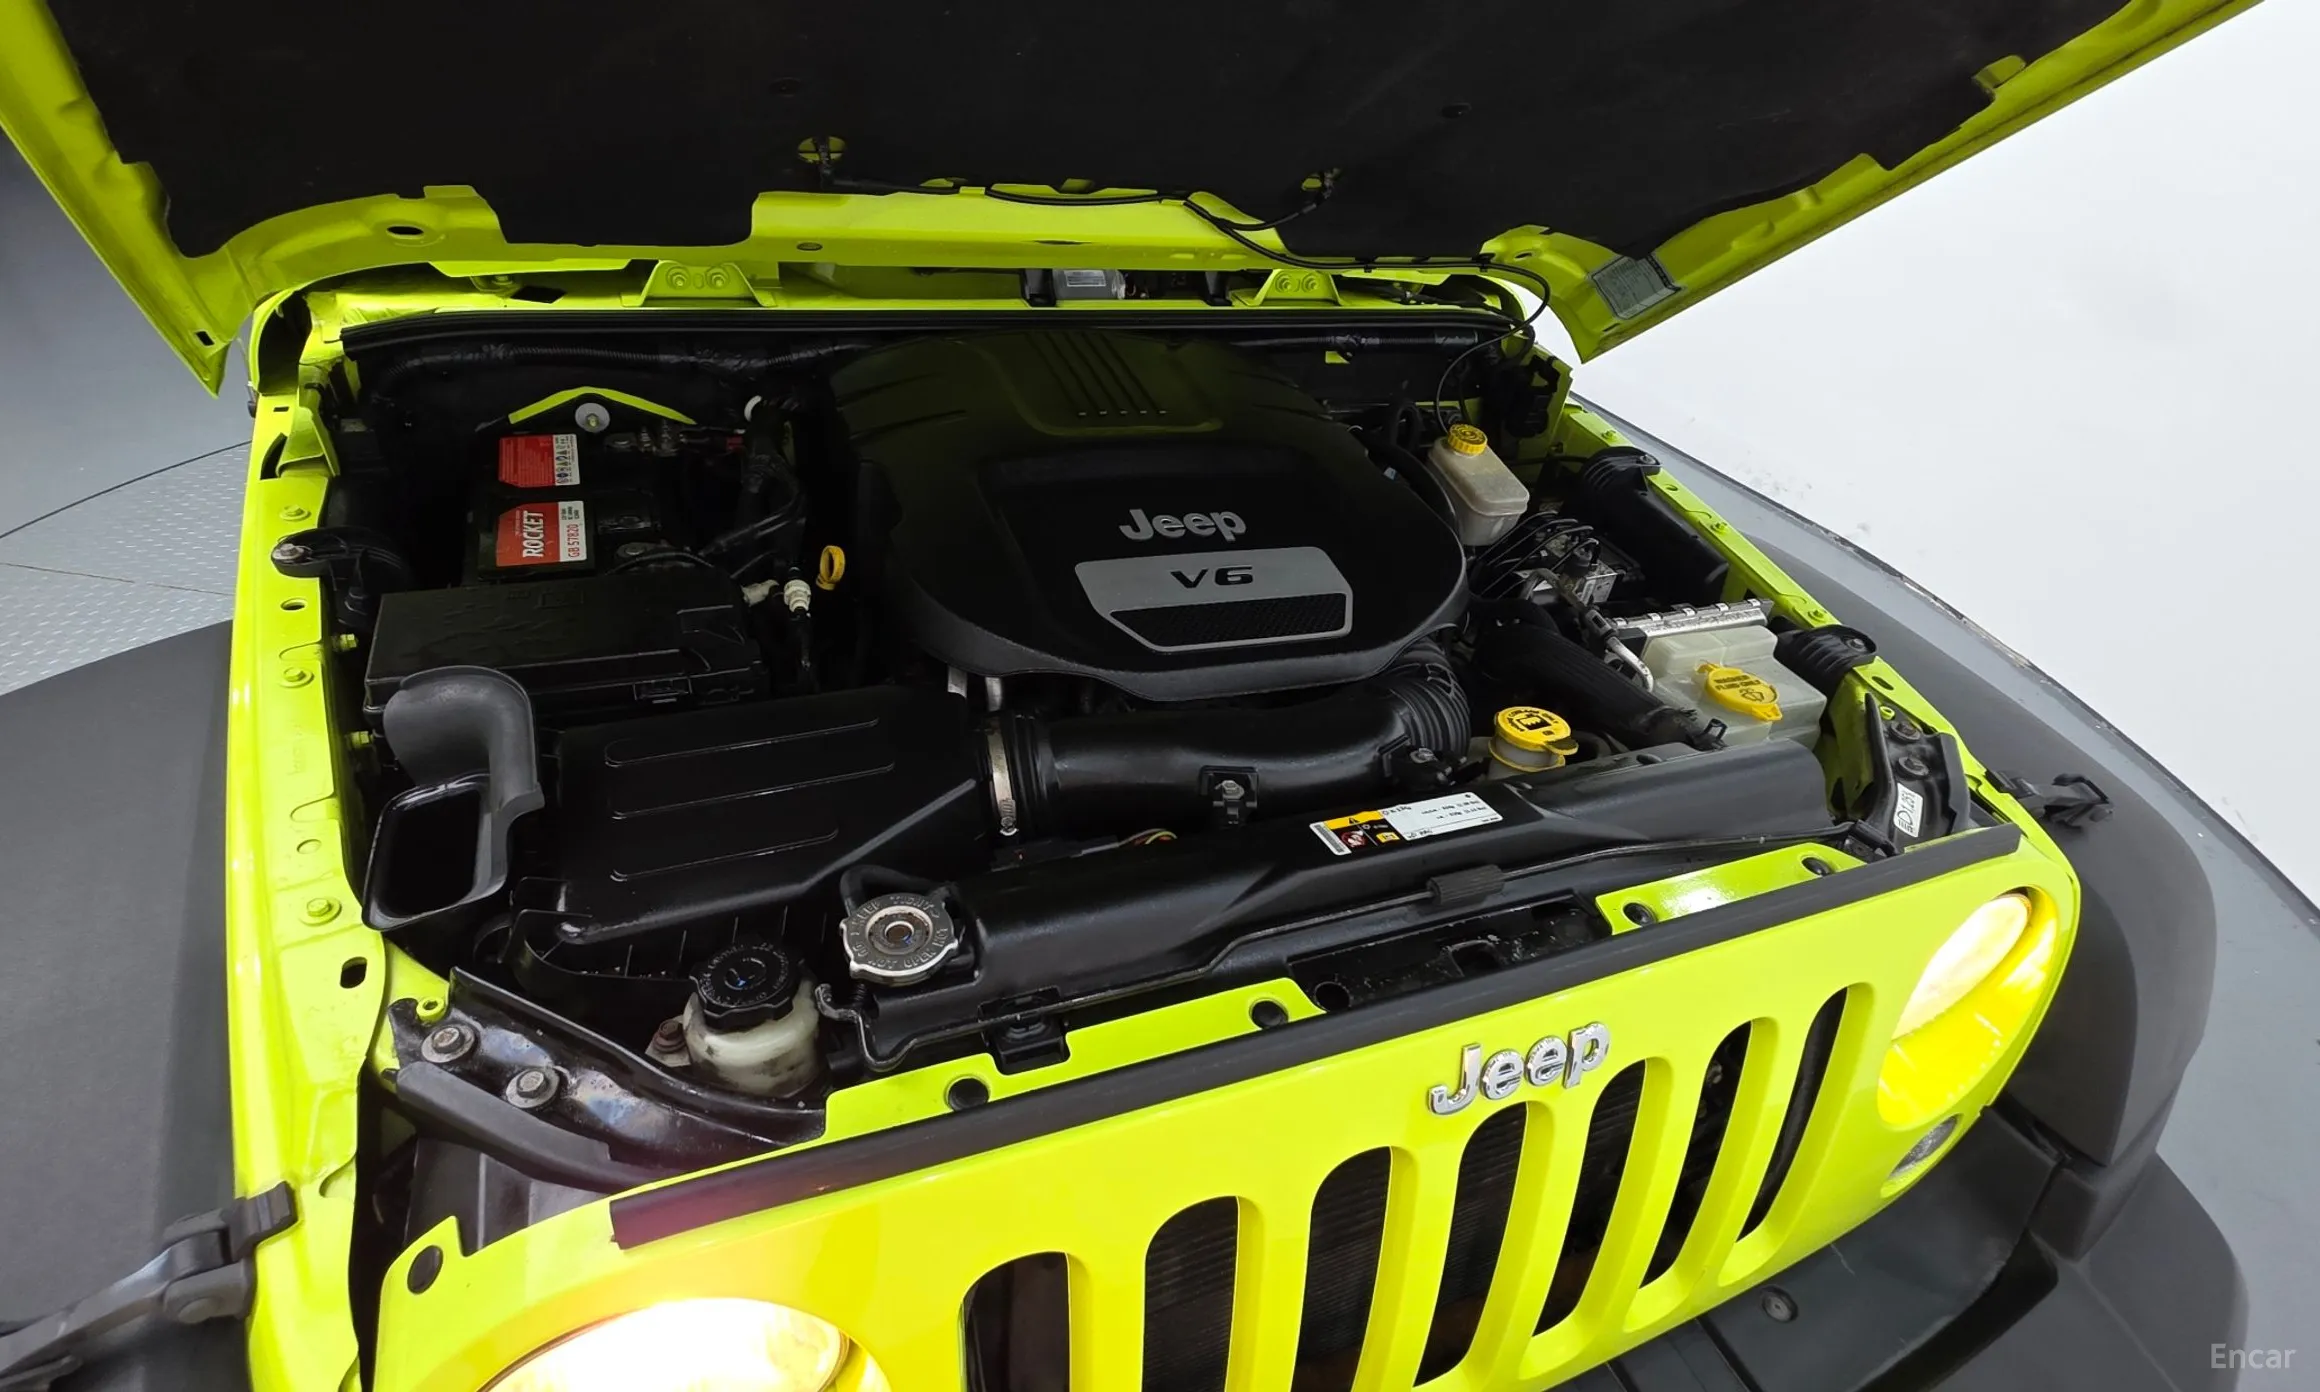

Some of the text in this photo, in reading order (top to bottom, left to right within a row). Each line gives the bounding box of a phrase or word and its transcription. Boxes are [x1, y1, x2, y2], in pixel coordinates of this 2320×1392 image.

[522, 510, 545, 558] ROCKET
[566, 523, 580, 546] 57820
[1118, 508, 1247, 541] Jeep
[568, 547, 580, 558] GB
[1170, 565, 1254, 589] V6
[1427, 1020, 1611, 1116] Jeep
